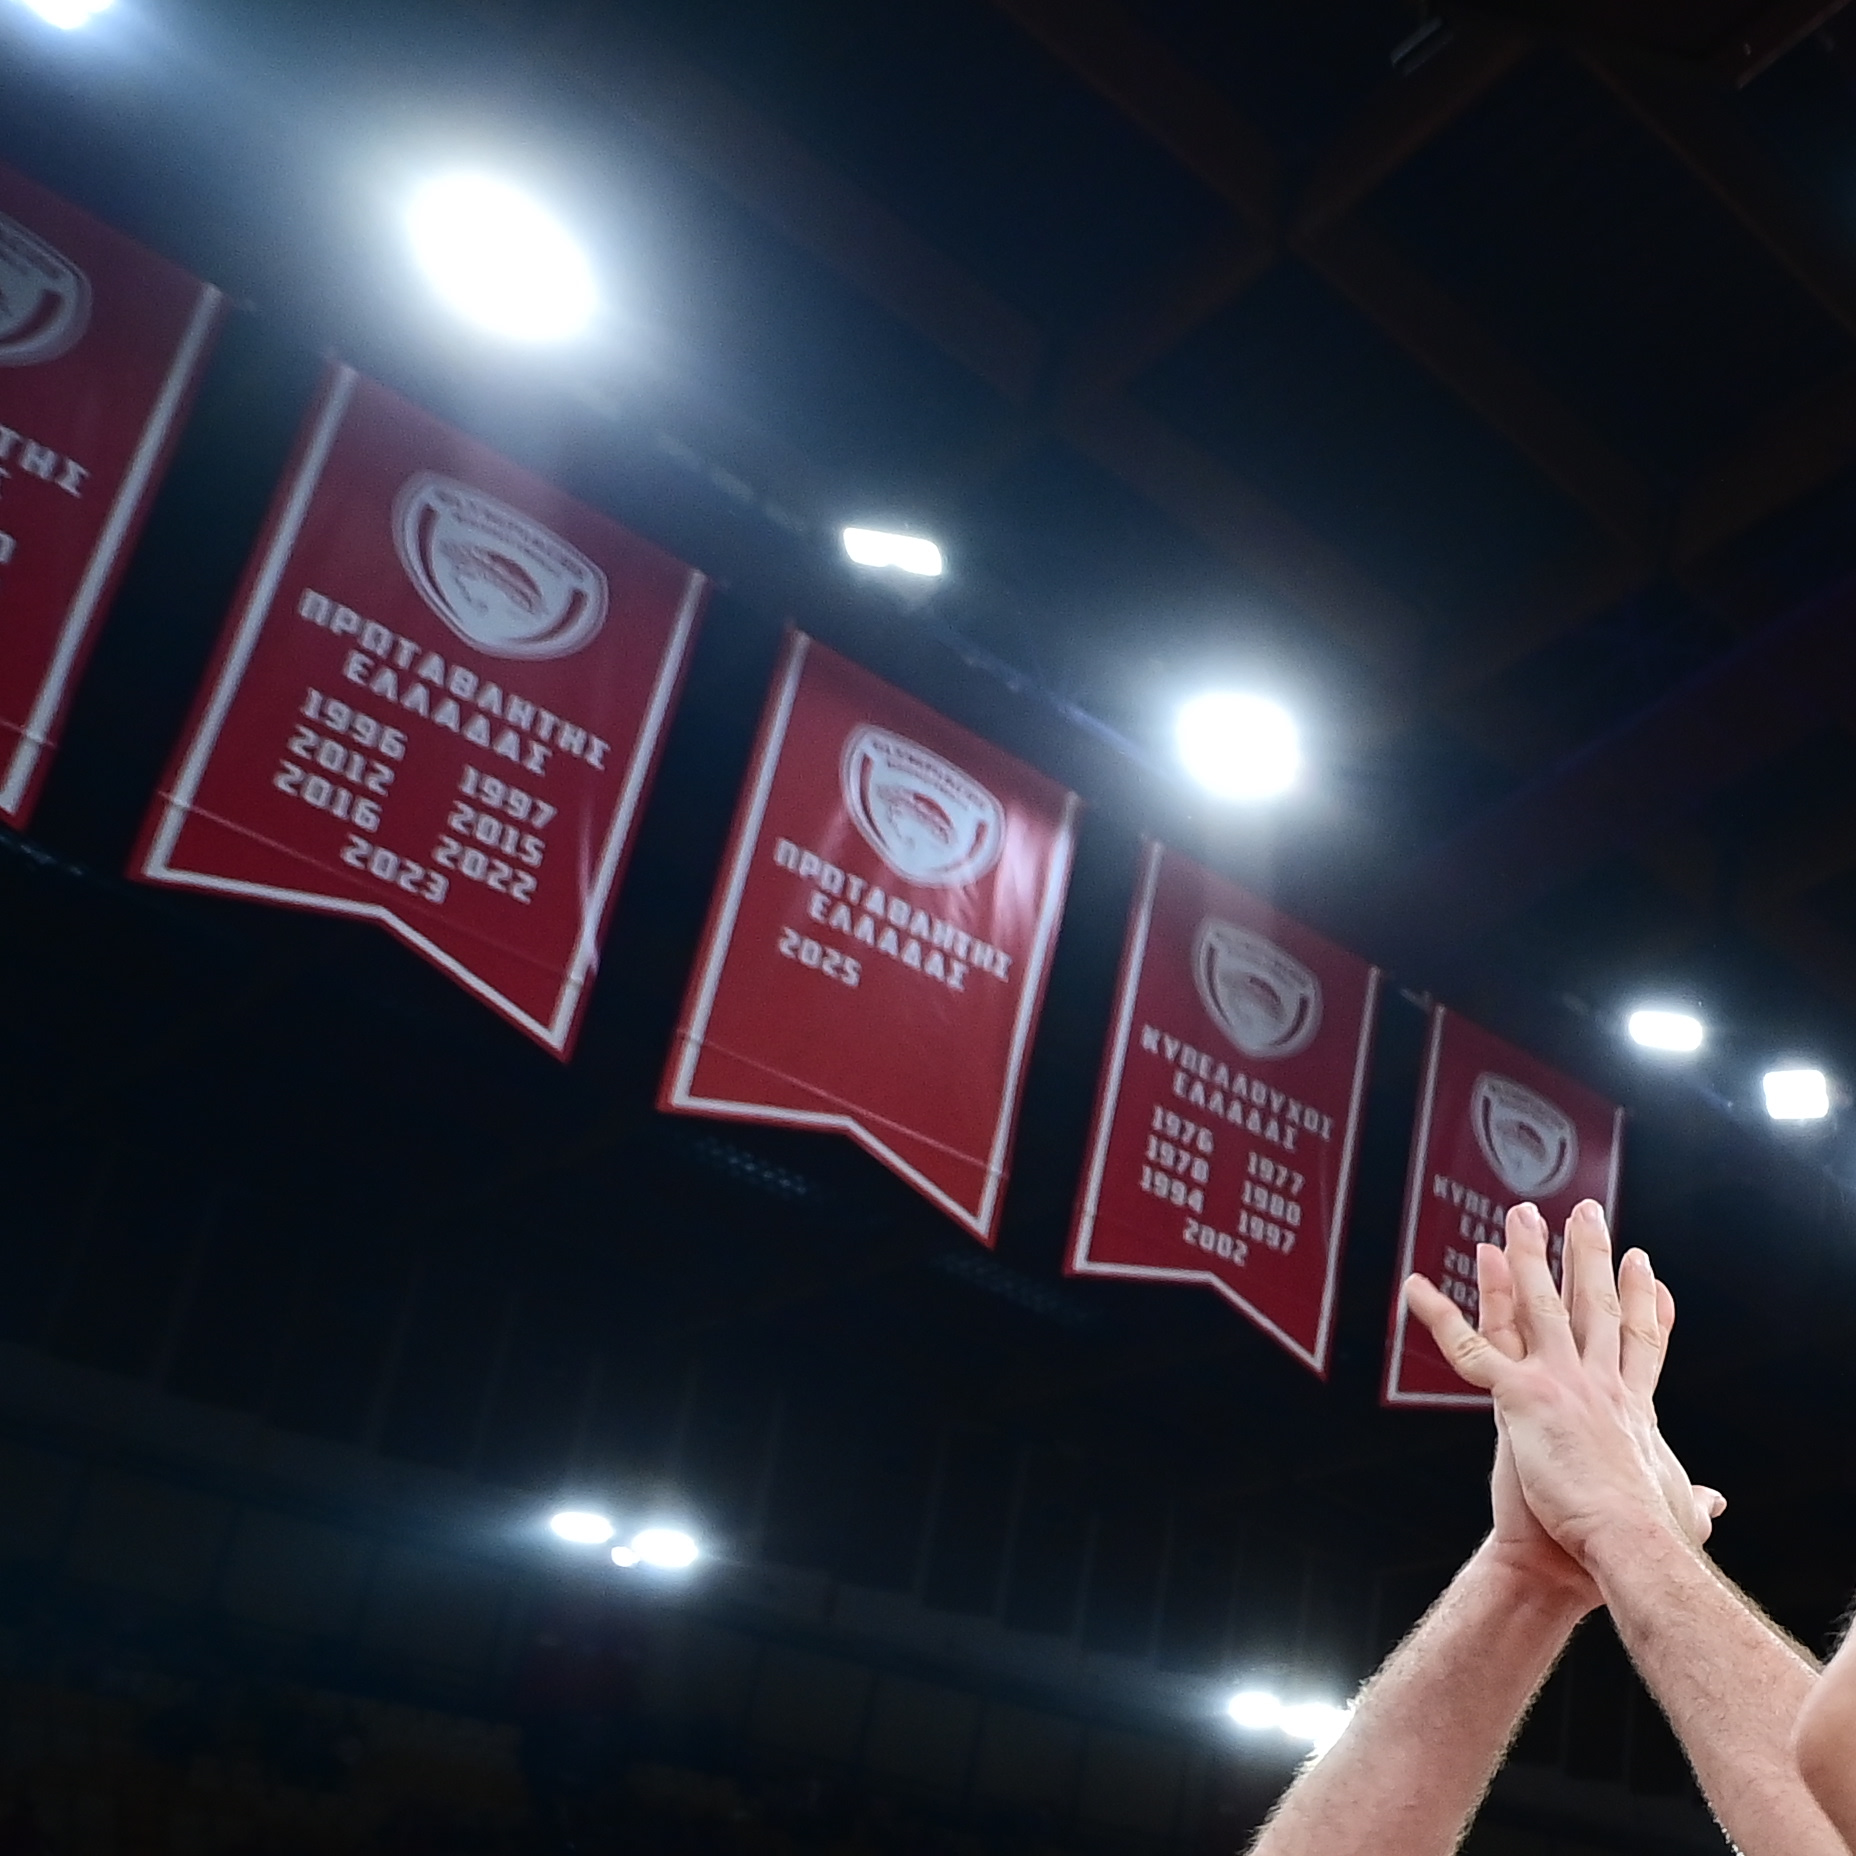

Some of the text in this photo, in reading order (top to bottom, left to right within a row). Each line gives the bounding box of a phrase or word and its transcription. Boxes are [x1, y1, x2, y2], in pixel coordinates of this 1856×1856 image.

[287, 724, 546, 868] 2012 2015
[301, 686, 558, 829] 1996 1997
[273, 759, 537, 905] 2016 2022
[339, 834, 449, 905] 2023
[778, 926, 862, 988] 2025
